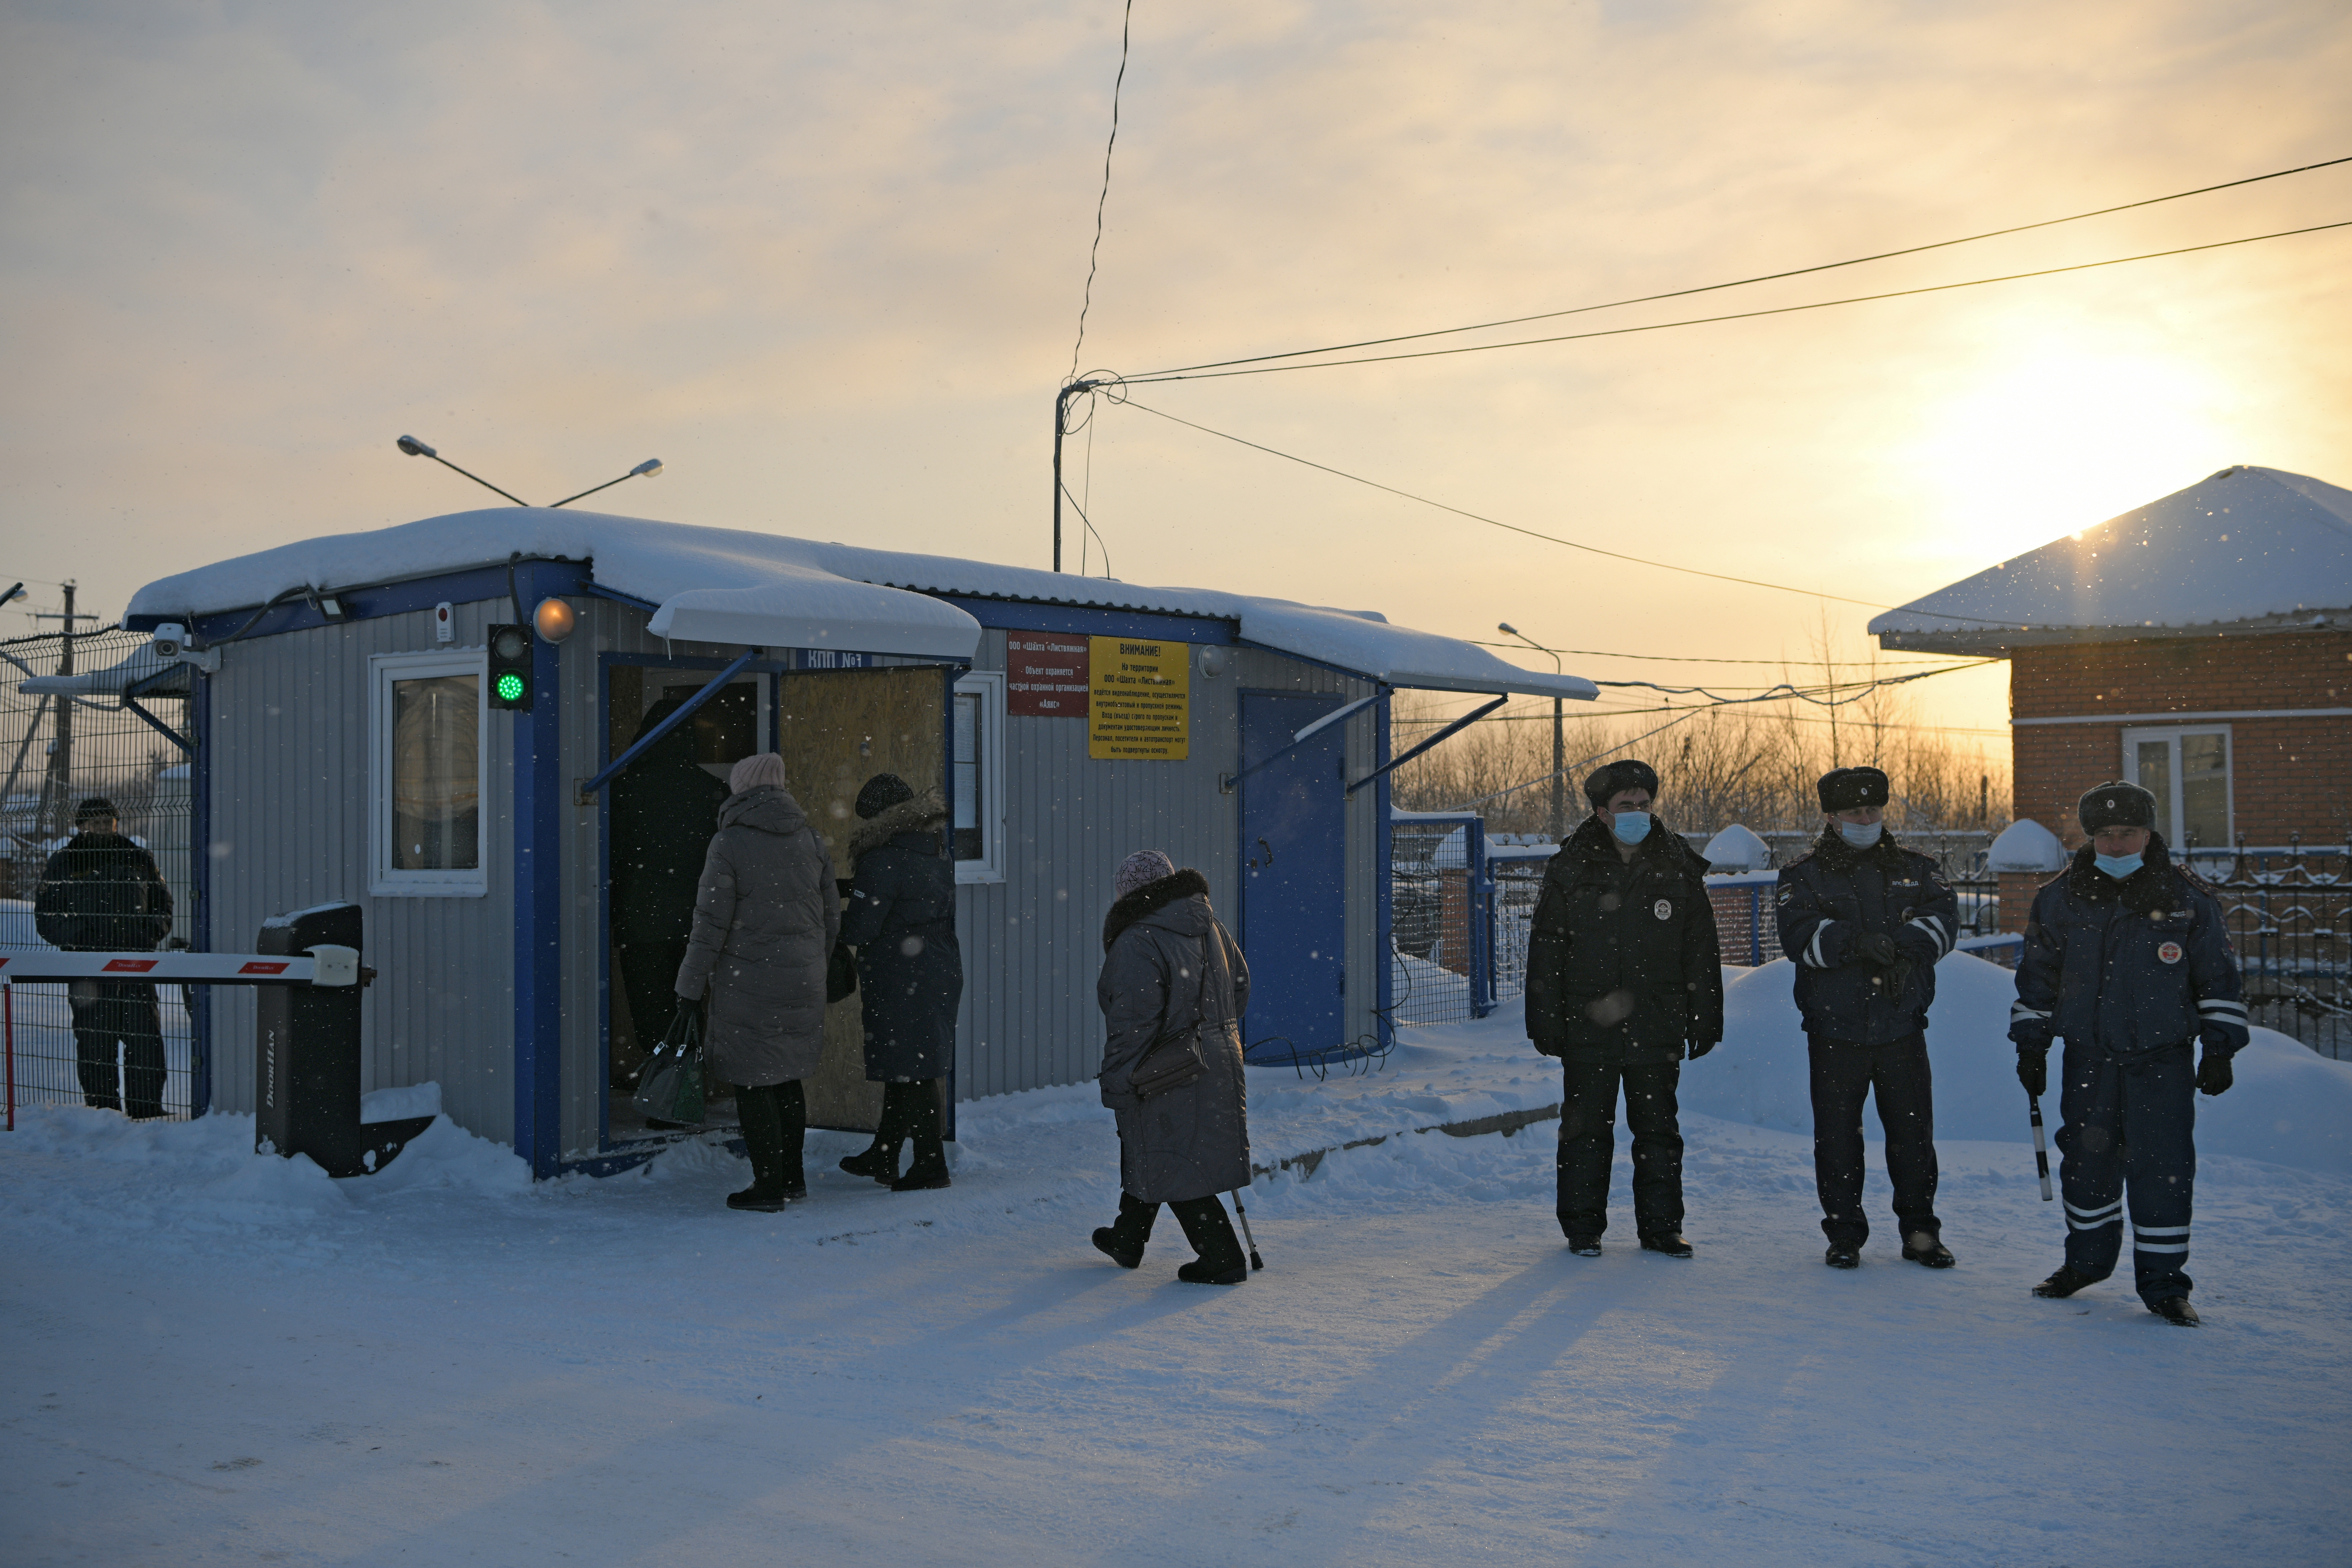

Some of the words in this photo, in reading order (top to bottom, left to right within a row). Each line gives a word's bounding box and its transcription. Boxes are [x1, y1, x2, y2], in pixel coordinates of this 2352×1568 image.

[1009, 641, 1020, 650] ООО
[1023, 642, 1045, 651] «Шахта
[1047, 643, 1087, 653] «Листвяжная»
[1120, 643, 1160, 657] ВНИМАНИЕ!
[808, 650, 835, 668] КПП
[1026, 666, 1044, 675] Объект
[1045, 668, 1073, 677] охраняется
[1130, 664, 1158, 673] территории
[1117, 675, 1136, 684] «Шахта
[1031, 683, 1054, 692] охранной
[1056, 684, 1088, 692] организацией
[1040, 699, 1060, 708] «Аякс»
